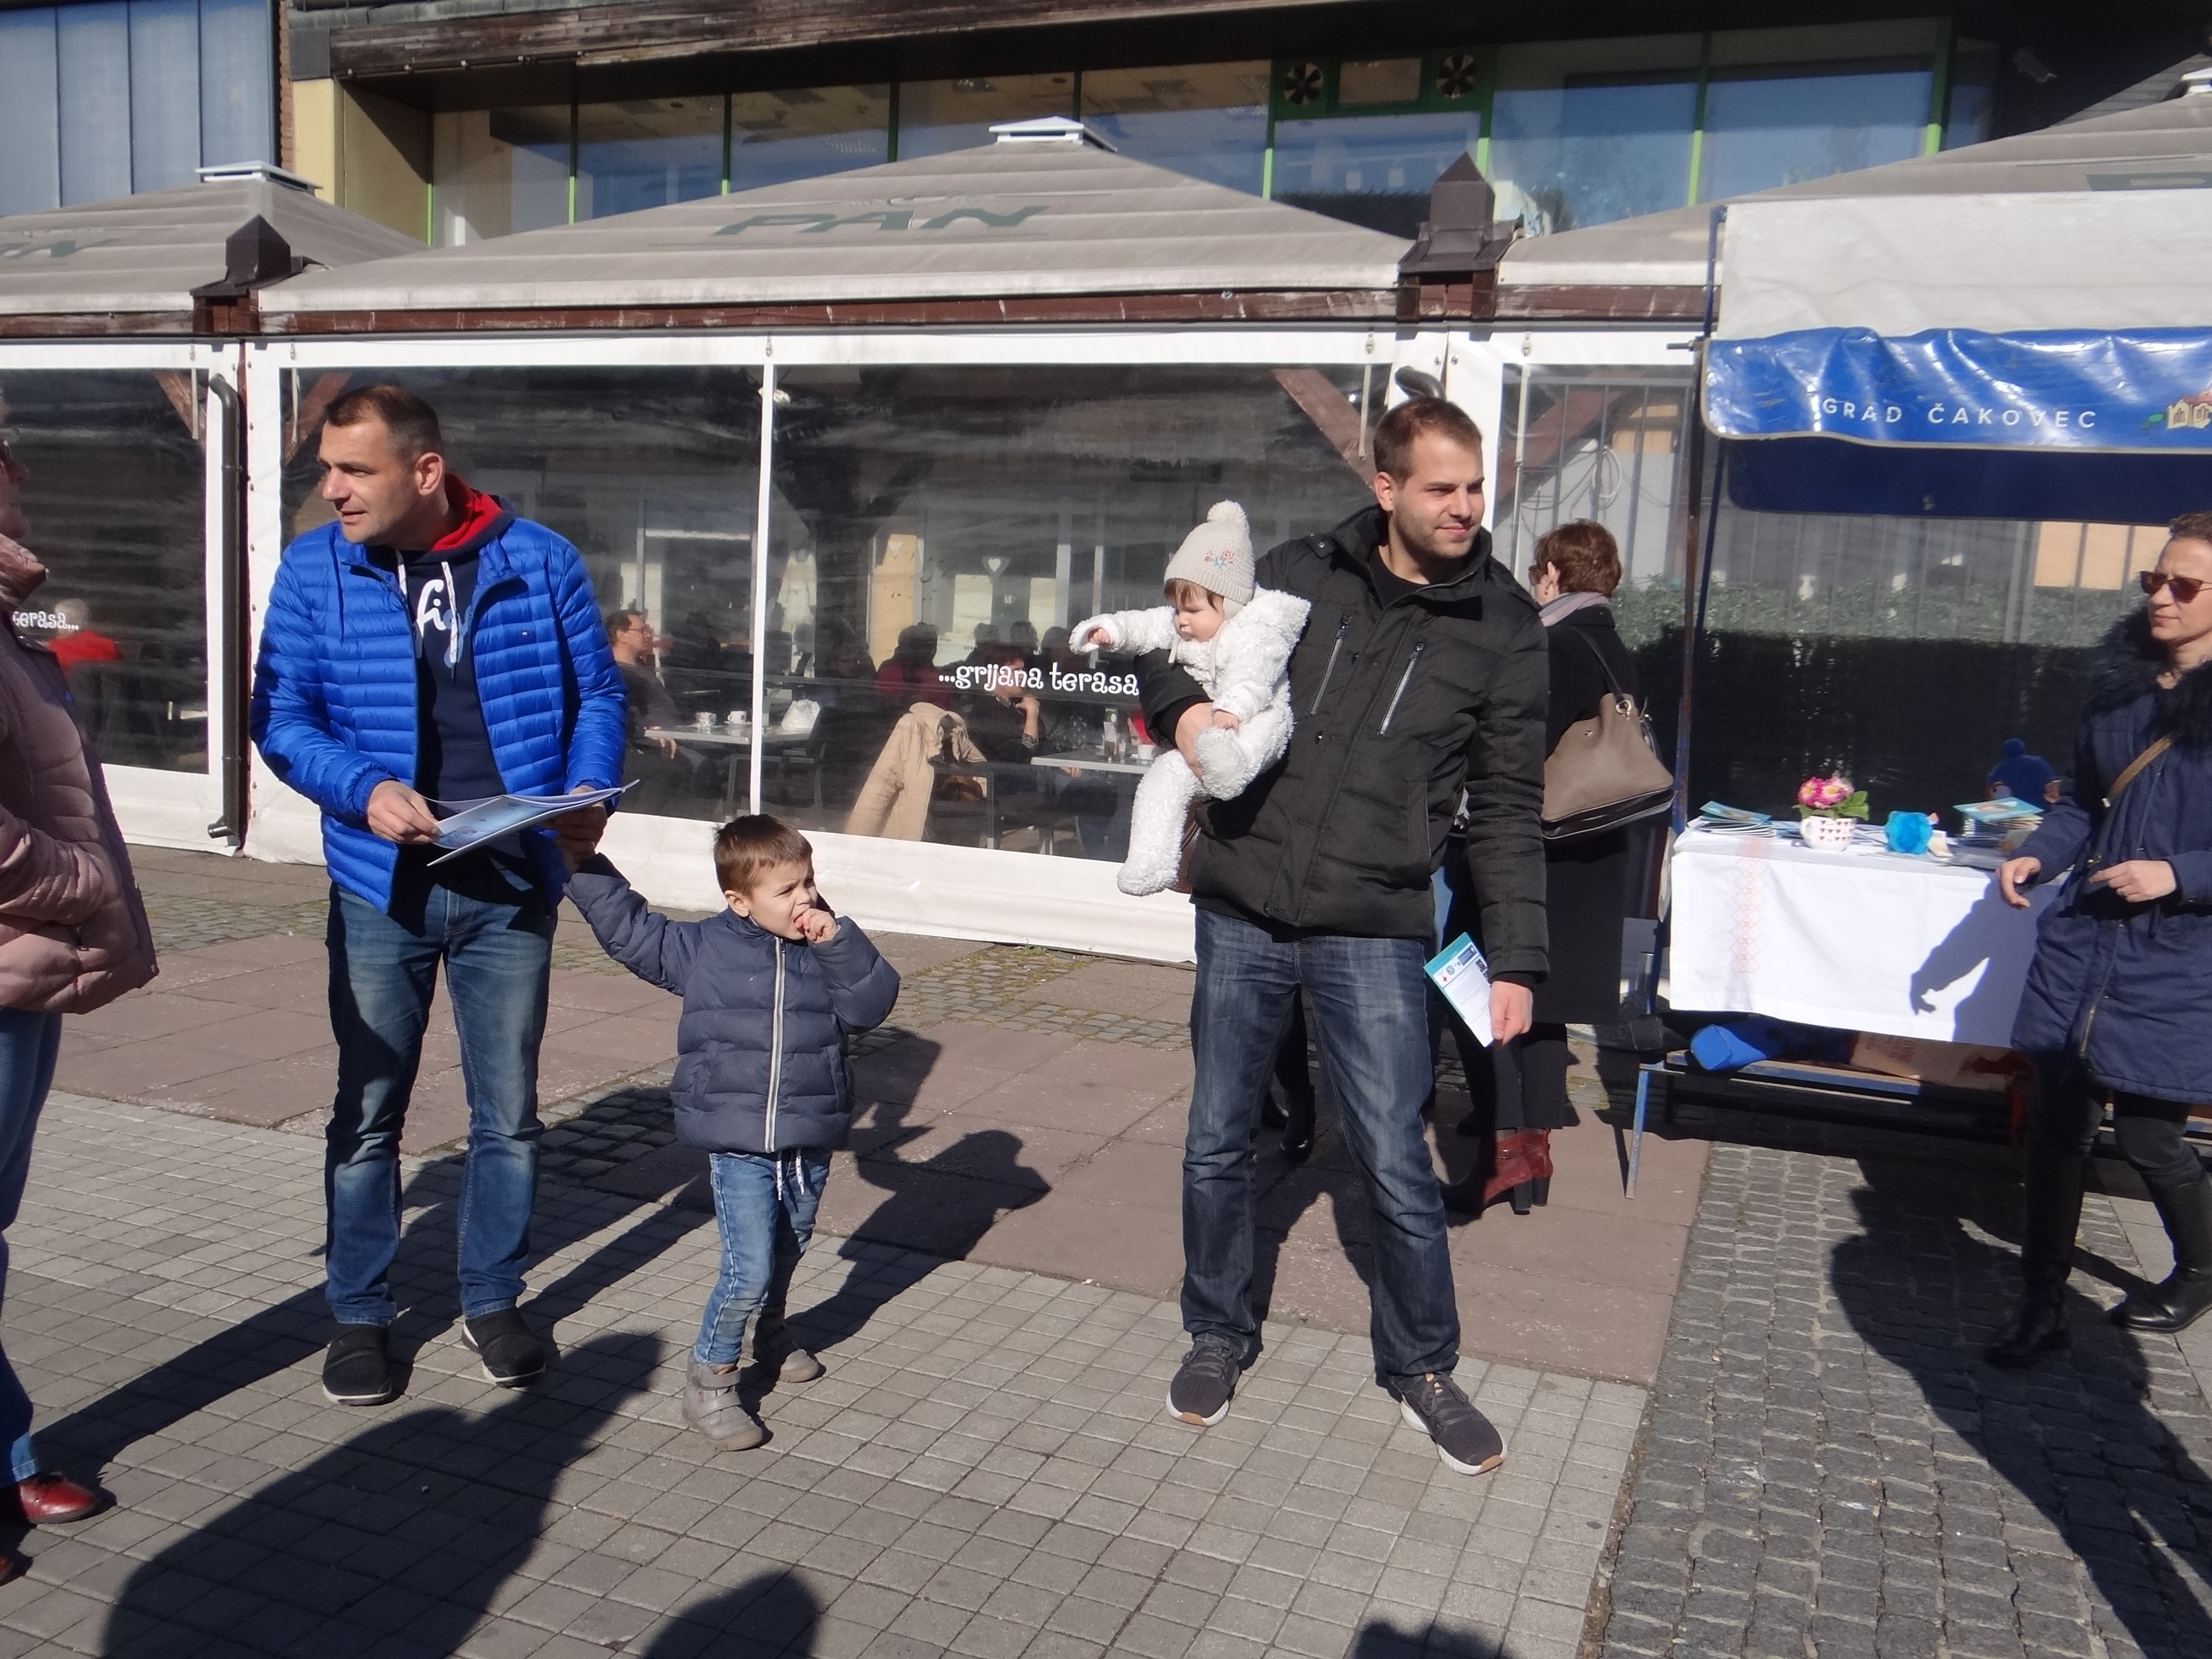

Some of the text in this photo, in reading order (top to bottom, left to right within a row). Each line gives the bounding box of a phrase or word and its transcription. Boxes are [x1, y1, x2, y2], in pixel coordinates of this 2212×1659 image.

[712, 205, 1051, 236] PAN
[1822, 398, 2096, 428] GRAD ČAKOVEC
[939, 661, 1140, 696] ...grijana terasa
